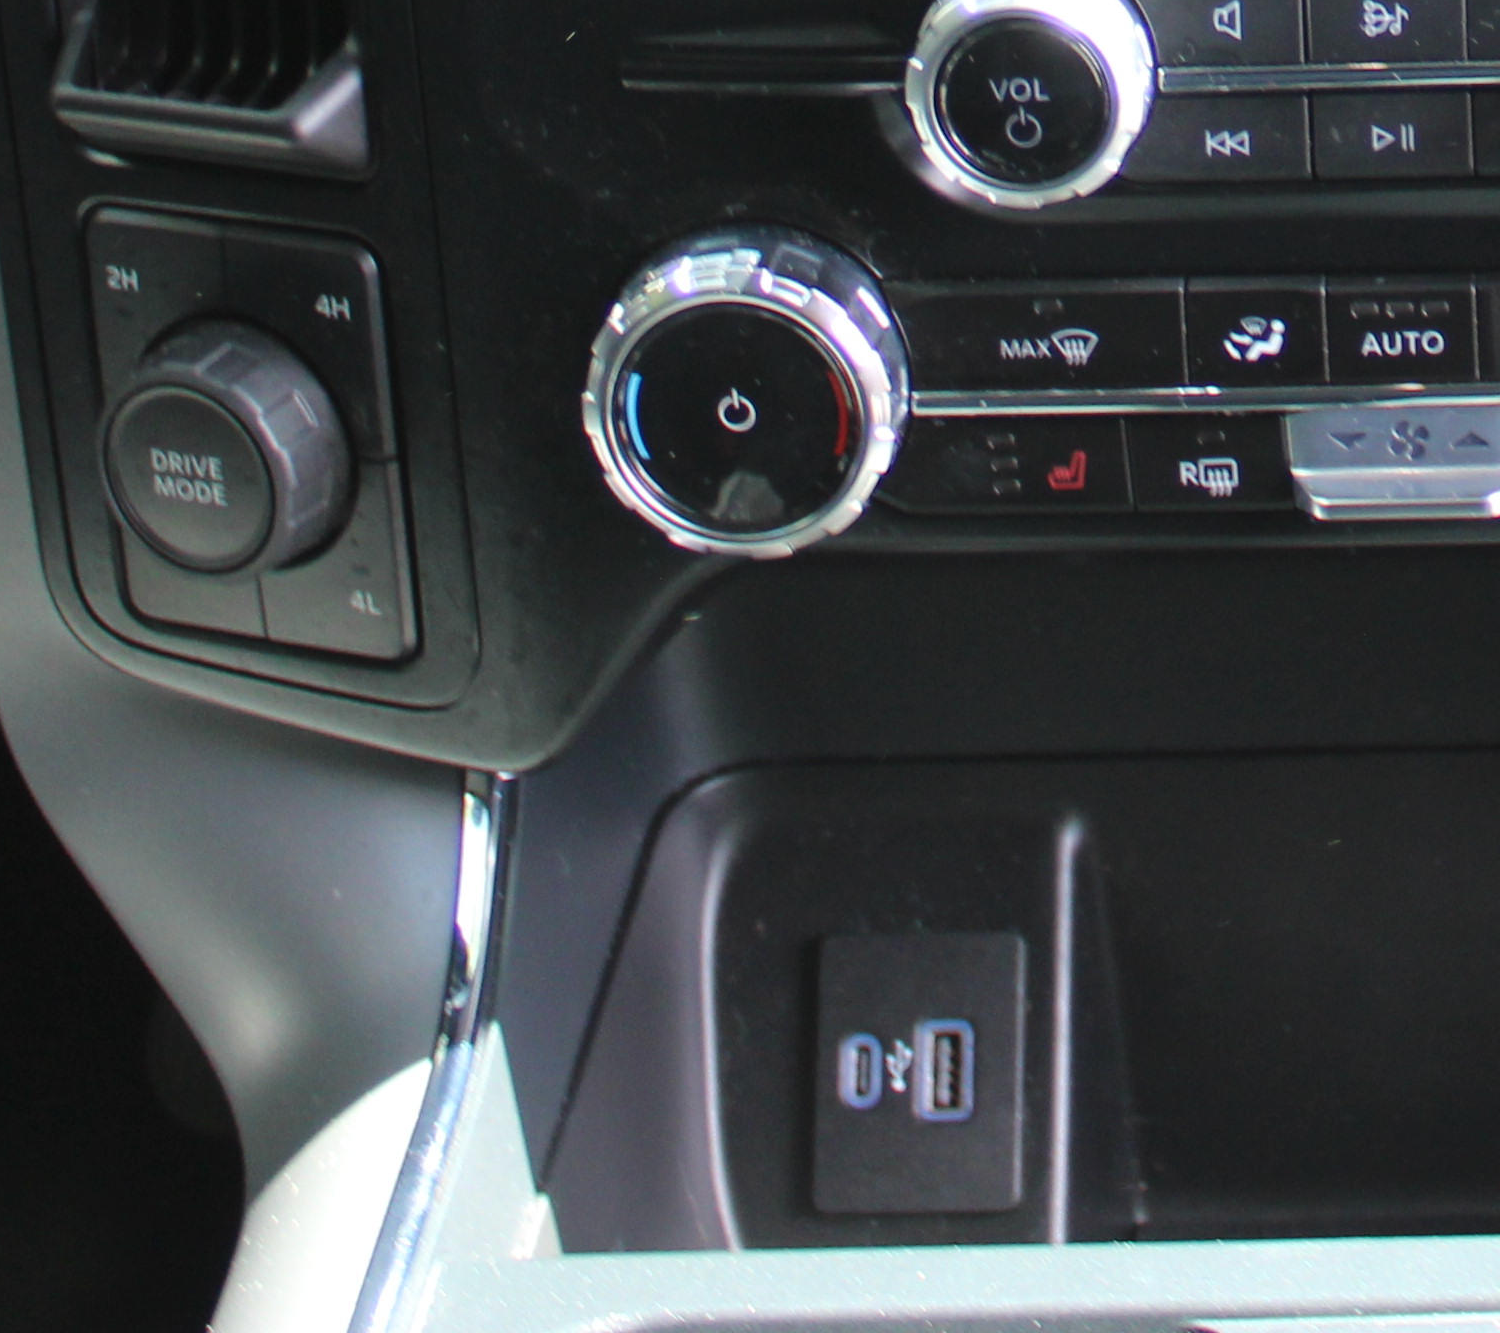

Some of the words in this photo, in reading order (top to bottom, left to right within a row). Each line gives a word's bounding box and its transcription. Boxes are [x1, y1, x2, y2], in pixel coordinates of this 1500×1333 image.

[989, 77, 1051, 104] VOL
[105, 264, 139, 293] 2H
[314, 293, 351, 321] 4H
[1000, 336, 1051, 360] MAX
[1360, 330, 1445, 358] AUTO
[150, 446, 223, 480] DRIVE
[153, 475, 228, 507] MODE
[350, 590, 382, 617] 4L
